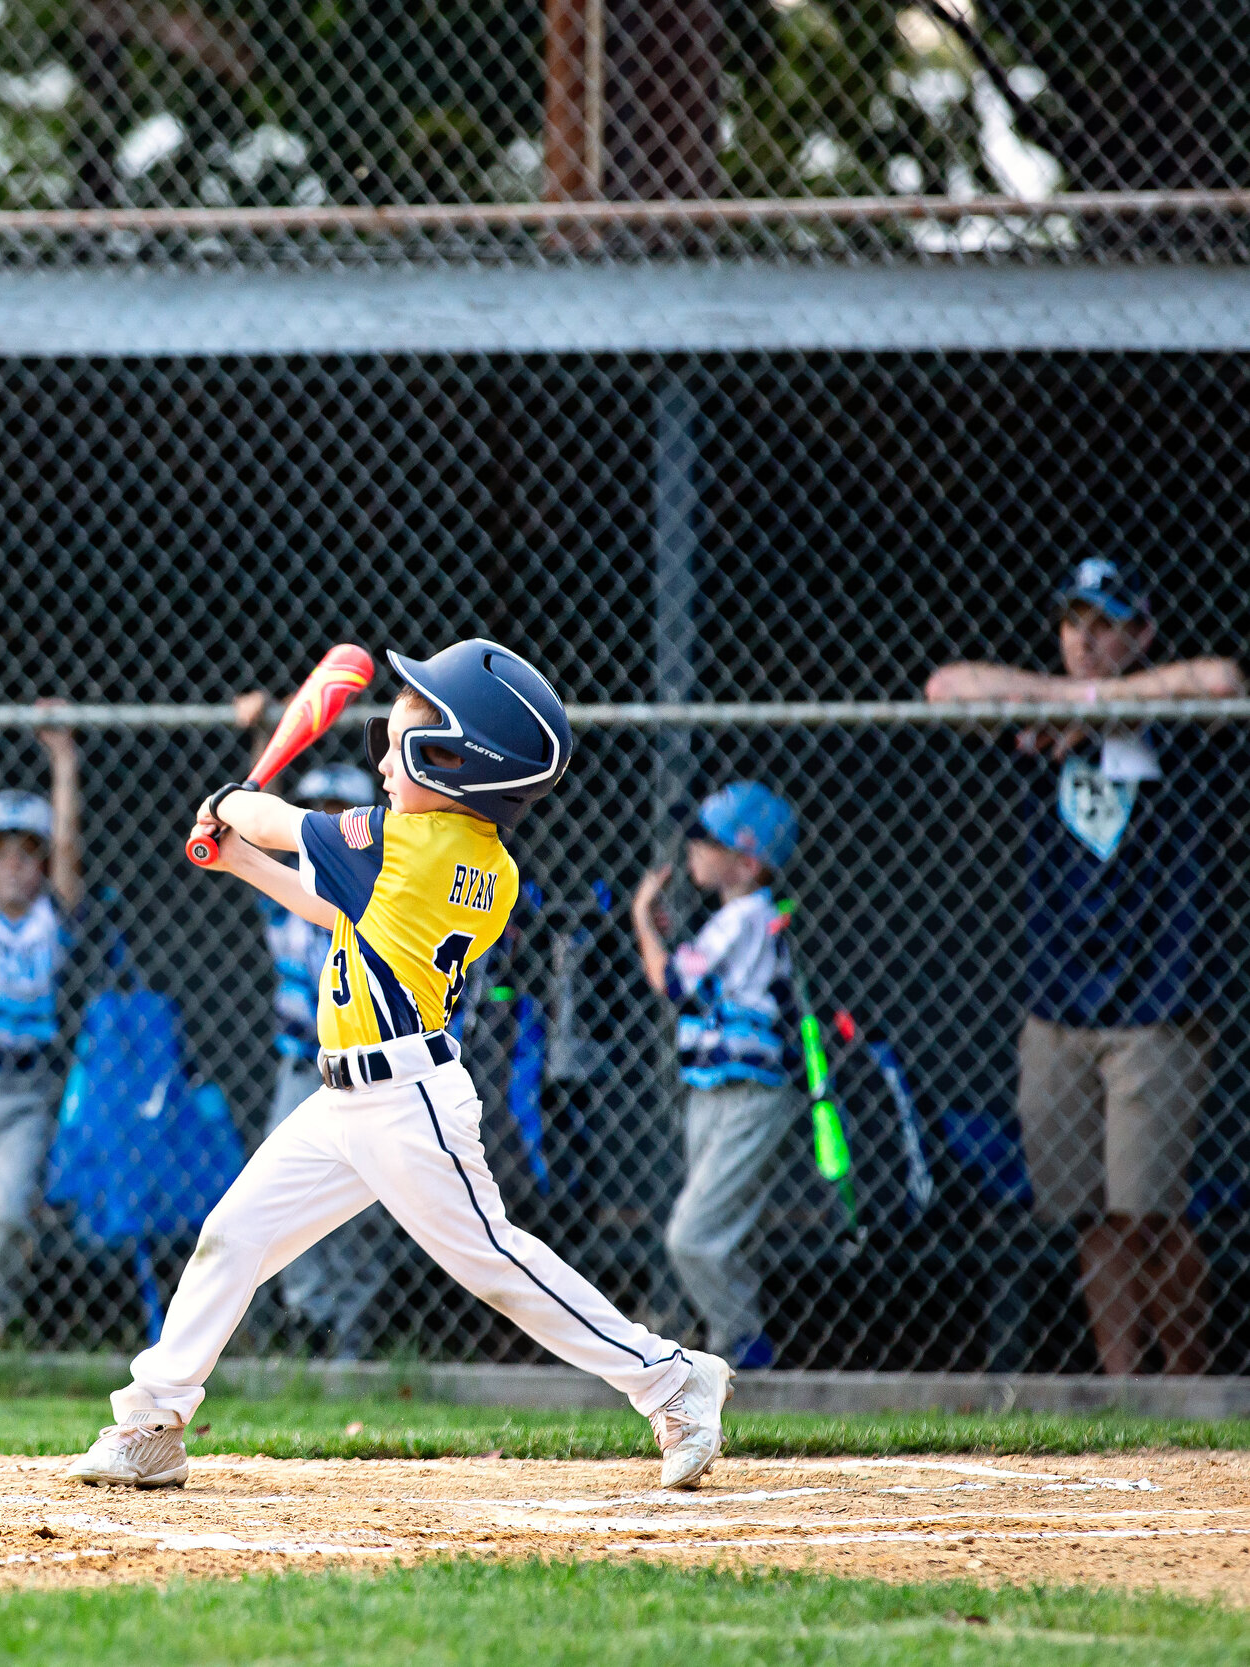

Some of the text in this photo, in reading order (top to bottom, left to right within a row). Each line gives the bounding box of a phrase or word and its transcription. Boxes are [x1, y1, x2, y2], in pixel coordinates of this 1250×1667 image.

[464, 741, 504, 762] EASTON
[448, 863, 498, 913] RYAN
[331, 947, 352, 1008] 3
